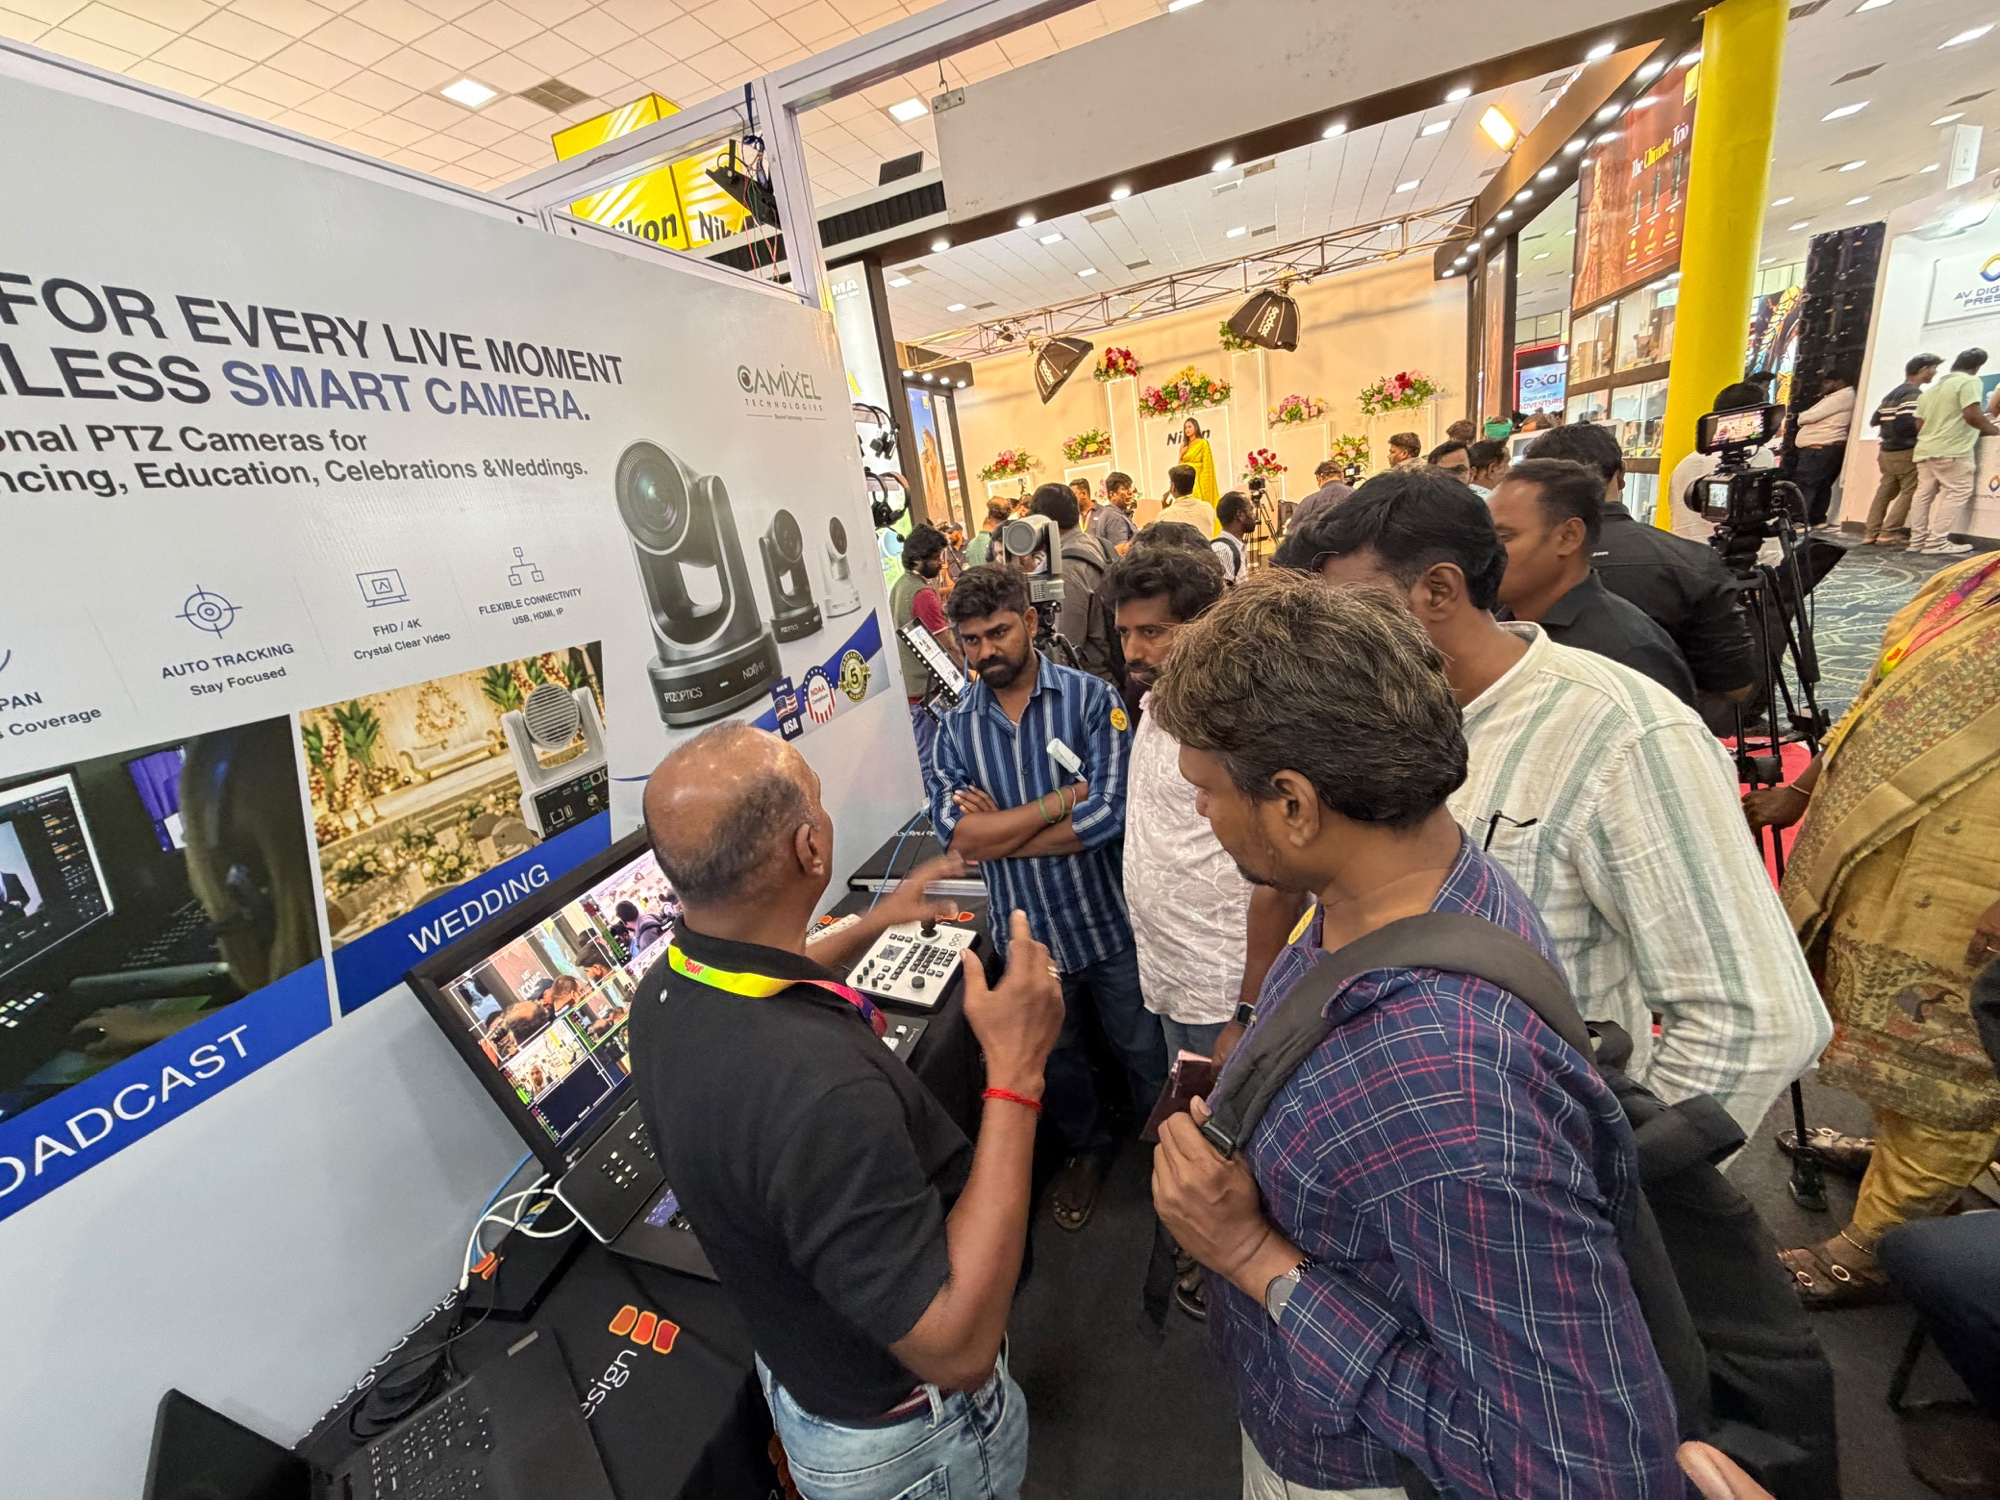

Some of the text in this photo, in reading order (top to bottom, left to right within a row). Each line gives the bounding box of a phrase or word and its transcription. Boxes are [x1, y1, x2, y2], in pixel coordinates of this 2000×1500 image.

[611, 213, 678, 242] kon
[698, 210, 739, 242] Nik
[1953, 290, 1973, 301] AV
[0, 272, 623, 385] FOR EVERY LIVE MOMENT
[0, 343, 591, 421] LESS SMART CAMERA.
[1520, 372, 1566, 389] exar
[744, 398, 824, 412] TECHNOLOGIES
[0, 424, 367, 453] nal PTZ Cameras for
[1167, 428, 1211, 446] Nin
[134, 460, 319, 490] Education,
[325, 459, 478, 483] Celebrations
[483, 458, 588, 480] &Weddings.
[478, 588, 583, 615] FLEXIBLE CONNECTIVITY
[373, 623, 398, 637] FHD
[406, 618, 422, 630] 4K
[512, 607, 564, 625] USB, HDMI, IP
[353, 631, 451, 661] Crystal Clear Video
[162, 643, 295, 680] AUTO TRACKING
[190, 666, 287, 697] Stay Focused
[850, 667, 859, 685] 5
[0, 691, 43, 712] PAN
[810, 684, 826, 698] NDAA
[8, 708, 102, 736] Coverage
[783, 717, 799, 735] USA
[408, 864, 551, 954] WEDDING
